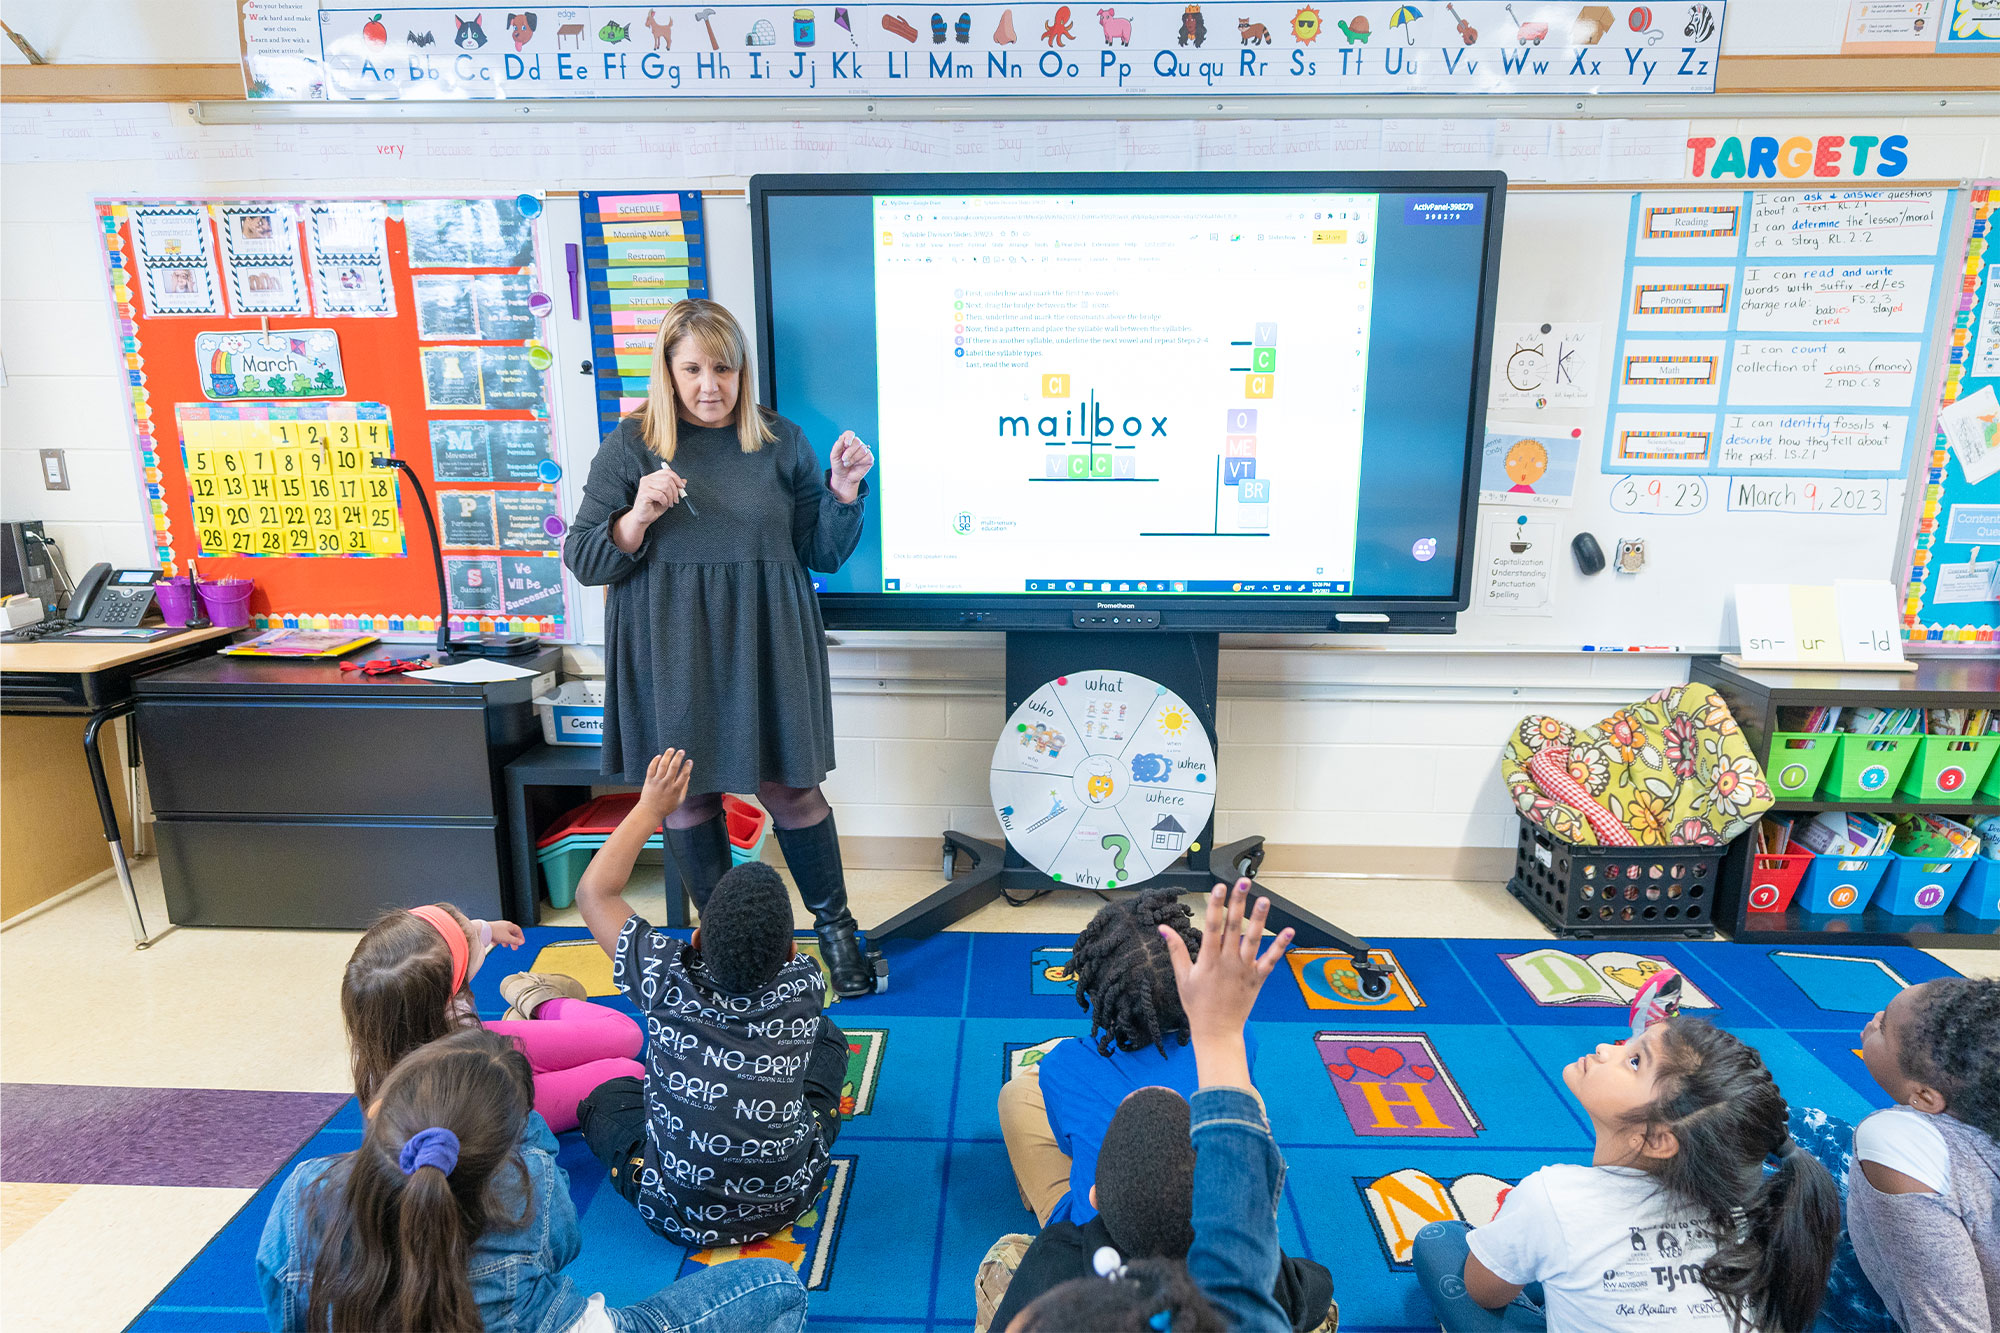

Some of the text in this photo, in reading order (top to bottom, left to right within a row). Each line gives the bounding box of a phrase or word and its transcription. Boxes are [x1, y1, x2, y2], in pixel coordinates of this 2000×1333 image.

[558, 9, 576, 20] edge
[504, 53, 540, 80] Dd
[557, 53, 588, 80] Ee
[604, 53, 626, 79] Ff
[641, 49, 680, 88] Gg
[697, 49, 730, 79] Hh
[749, 52, 769, 79] Ii
[789, 52, 815, 88] Jj
[833, 52, 862, 78] Kk
[930, 51, 972, 78] Mm
[988, 51, 1022, 78] Nn
[1039, 51, 1079, 77] Oo
[1101, 50, 1131, 87] Pp
[1154, 50, 1189, 77] Qu
[1199, 63, 1223, 86] qu
[1240, 49, 1268, 76] Rr
[1290, 49, 1316, 76] Ss
[1339, 48, 1363, 75] Tt
[1385, 48, 1416, 75] Uu
[1442, 45, 1478, 75] Vv
[1501, 48, 1549, 75] Ww
[1570, 48, 1601, 75] Xx
[1625, 48, 1657, 85] Yy
[1677, 48, 1708, 75] Zz
[377, 145, 404, 159] very
[1686, 135, 1909, 179] TARGETS
[1804, 192, 1821, 200] ask
[1844, 191, 1883, 202] answer
[1888, 190, 1932, 200] questions
[619, 205, 662, 215] SCHEDULE
[1414, 203, 1473, 211] ActivPanel-398279
[1757, 206, 1784, 216] about
[1675, 218, 1708, 227] Reading
[1792, 219, 1839, 230] determine
[1847, 215, 1863, 226] the
[613, 229, 671, 240] Morning Work
[1755, 235, 1818, 250] of story
[627, 252, 666, 261] Restroom
[631, 274, 665, 285] Reading
[1804, 268, 1834, 278] read
[1842, 268, 1861, 277] and
[1866, 267, 1892, 275] write
[1745, 285, 1779, 295] words
[1788, 283, 1812, 292] with
[629, 298, 673, 306] SPECIALS
[1661, 297, 1691, 305] Phonics
[1740, 298, 1779, 317] change
[1816, 303, 1902, 317] babies stayed
[1792, 344, 1826, 353] count
[243, 355, 297, 372] March
[1258, 351, 1270, 369] C
[1737, 360, 1797, 372] collection
[1802, 359, 1817, 372] of
[1660, 365, 1679, 374] Math
[1780, 414, 1829, 438] identify
[1834, 415, 1875, 431] fossils
[278, 426, 377, 444] 1 2 3 4
[1229, 439, 1253, 457] ME
[1726, 432, 1887, 453] describe how they tell about
[198, 451, 355, 471] 5 6 7 8 9 10
[1725, 448, 1742, 460] the
[1072, 458, 1084, 475] C
[1095, 457, 1107, 474] C
[1229, 461, 1252, 478] VT
[1244, 482, 1264, 499] BR
[1739, 484, 1795, 507] March
[1830, 488, 1881, 510] 2023
[515, 563, 532, 574] We
[1494, 558, 1543, 566] Capitalization
[1492, 569, 1546, 578] Understanding
[508, 578, 541, 590] Will Be
[505, 583, 563, 611] Successful!
[1490, 591, 1518, 599] Spelling
[1803, 640, 1824, 650] ur
[1086, 676, 1122, 692] what
[1028, 699, 1054, 718] who
[1178, 757, 1205, 770] when
[1791, 772, 1955, 785] 1 2 3
[1146, 790, 1185, 806] where
[1075, 869, 1101, 889] why
[1761, 891, 1934, 903] 9 10 11
[1526, 955, 1600, 997] D
[748, 1019, 784, 1038] NO
[703, 1046, 801, 1077] NO DRIP
[668, 1071, 728, 1103] DRIP
[736, 1098, 776, 1122] NO
[1350, 1081, 1456, 1130] H
[689, 1130, 795, 1158] NO DRIP
